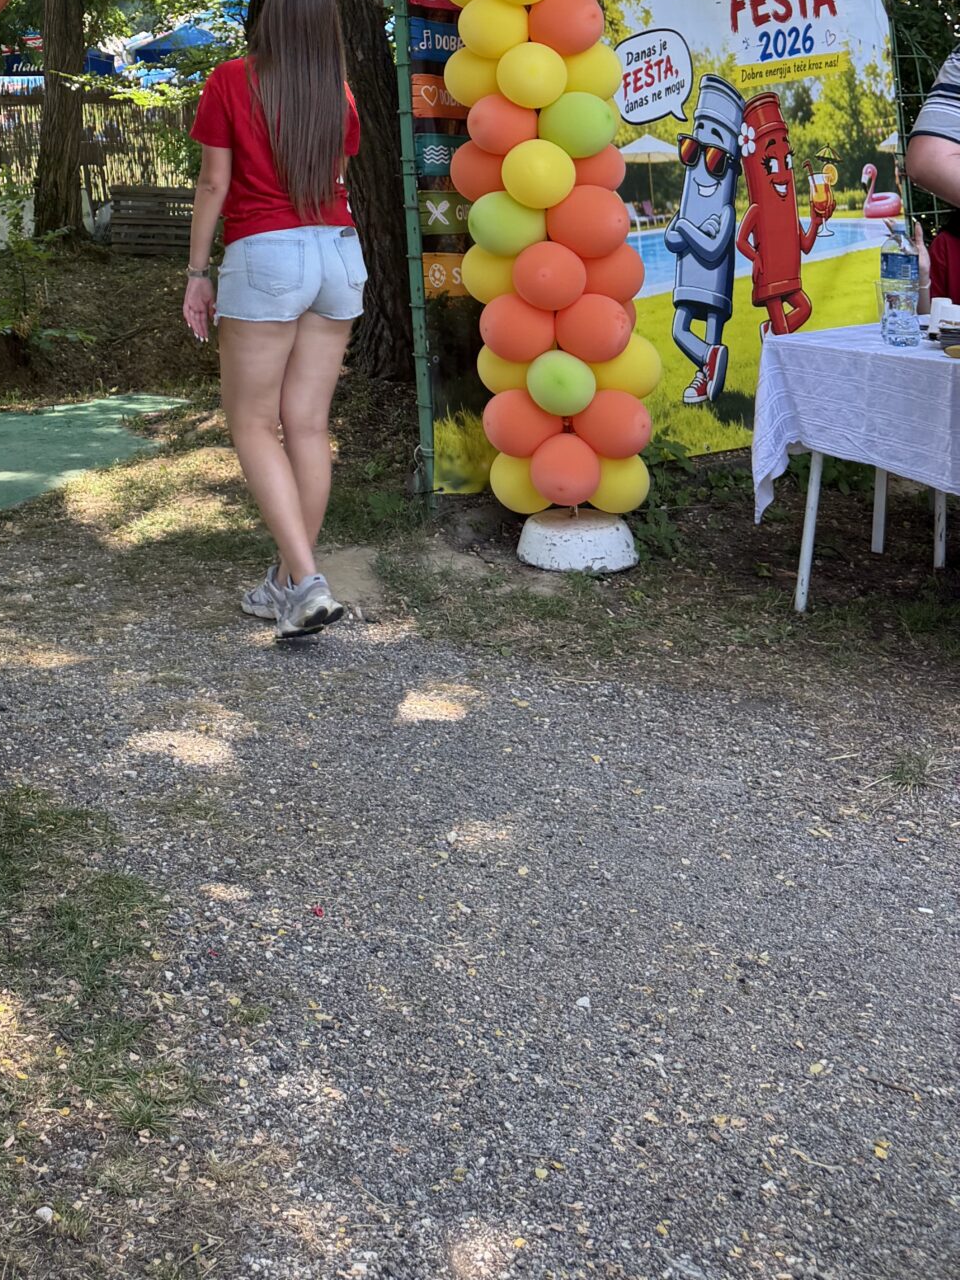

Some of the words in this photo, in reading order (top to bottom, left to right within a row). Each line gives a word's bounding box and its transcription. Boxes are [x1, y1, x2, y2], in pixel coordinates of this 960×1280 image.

[626, 45, 657, 66] Danas
[659, 38, 667, 56] je
[758, 23, 815, 62] 2026
[622, 54, 679, 101] FEŠTA,
[741, 67, 763, 83] Dobra
[765, 63, 792, 79] energija
[808, 59, 822, 71] kroz
[824, 55, 840, 68] nas!
[624, 95, 649, 114] danas
[652, 89, 662, 102] ne
[664, 79, 685, 97] mogu
